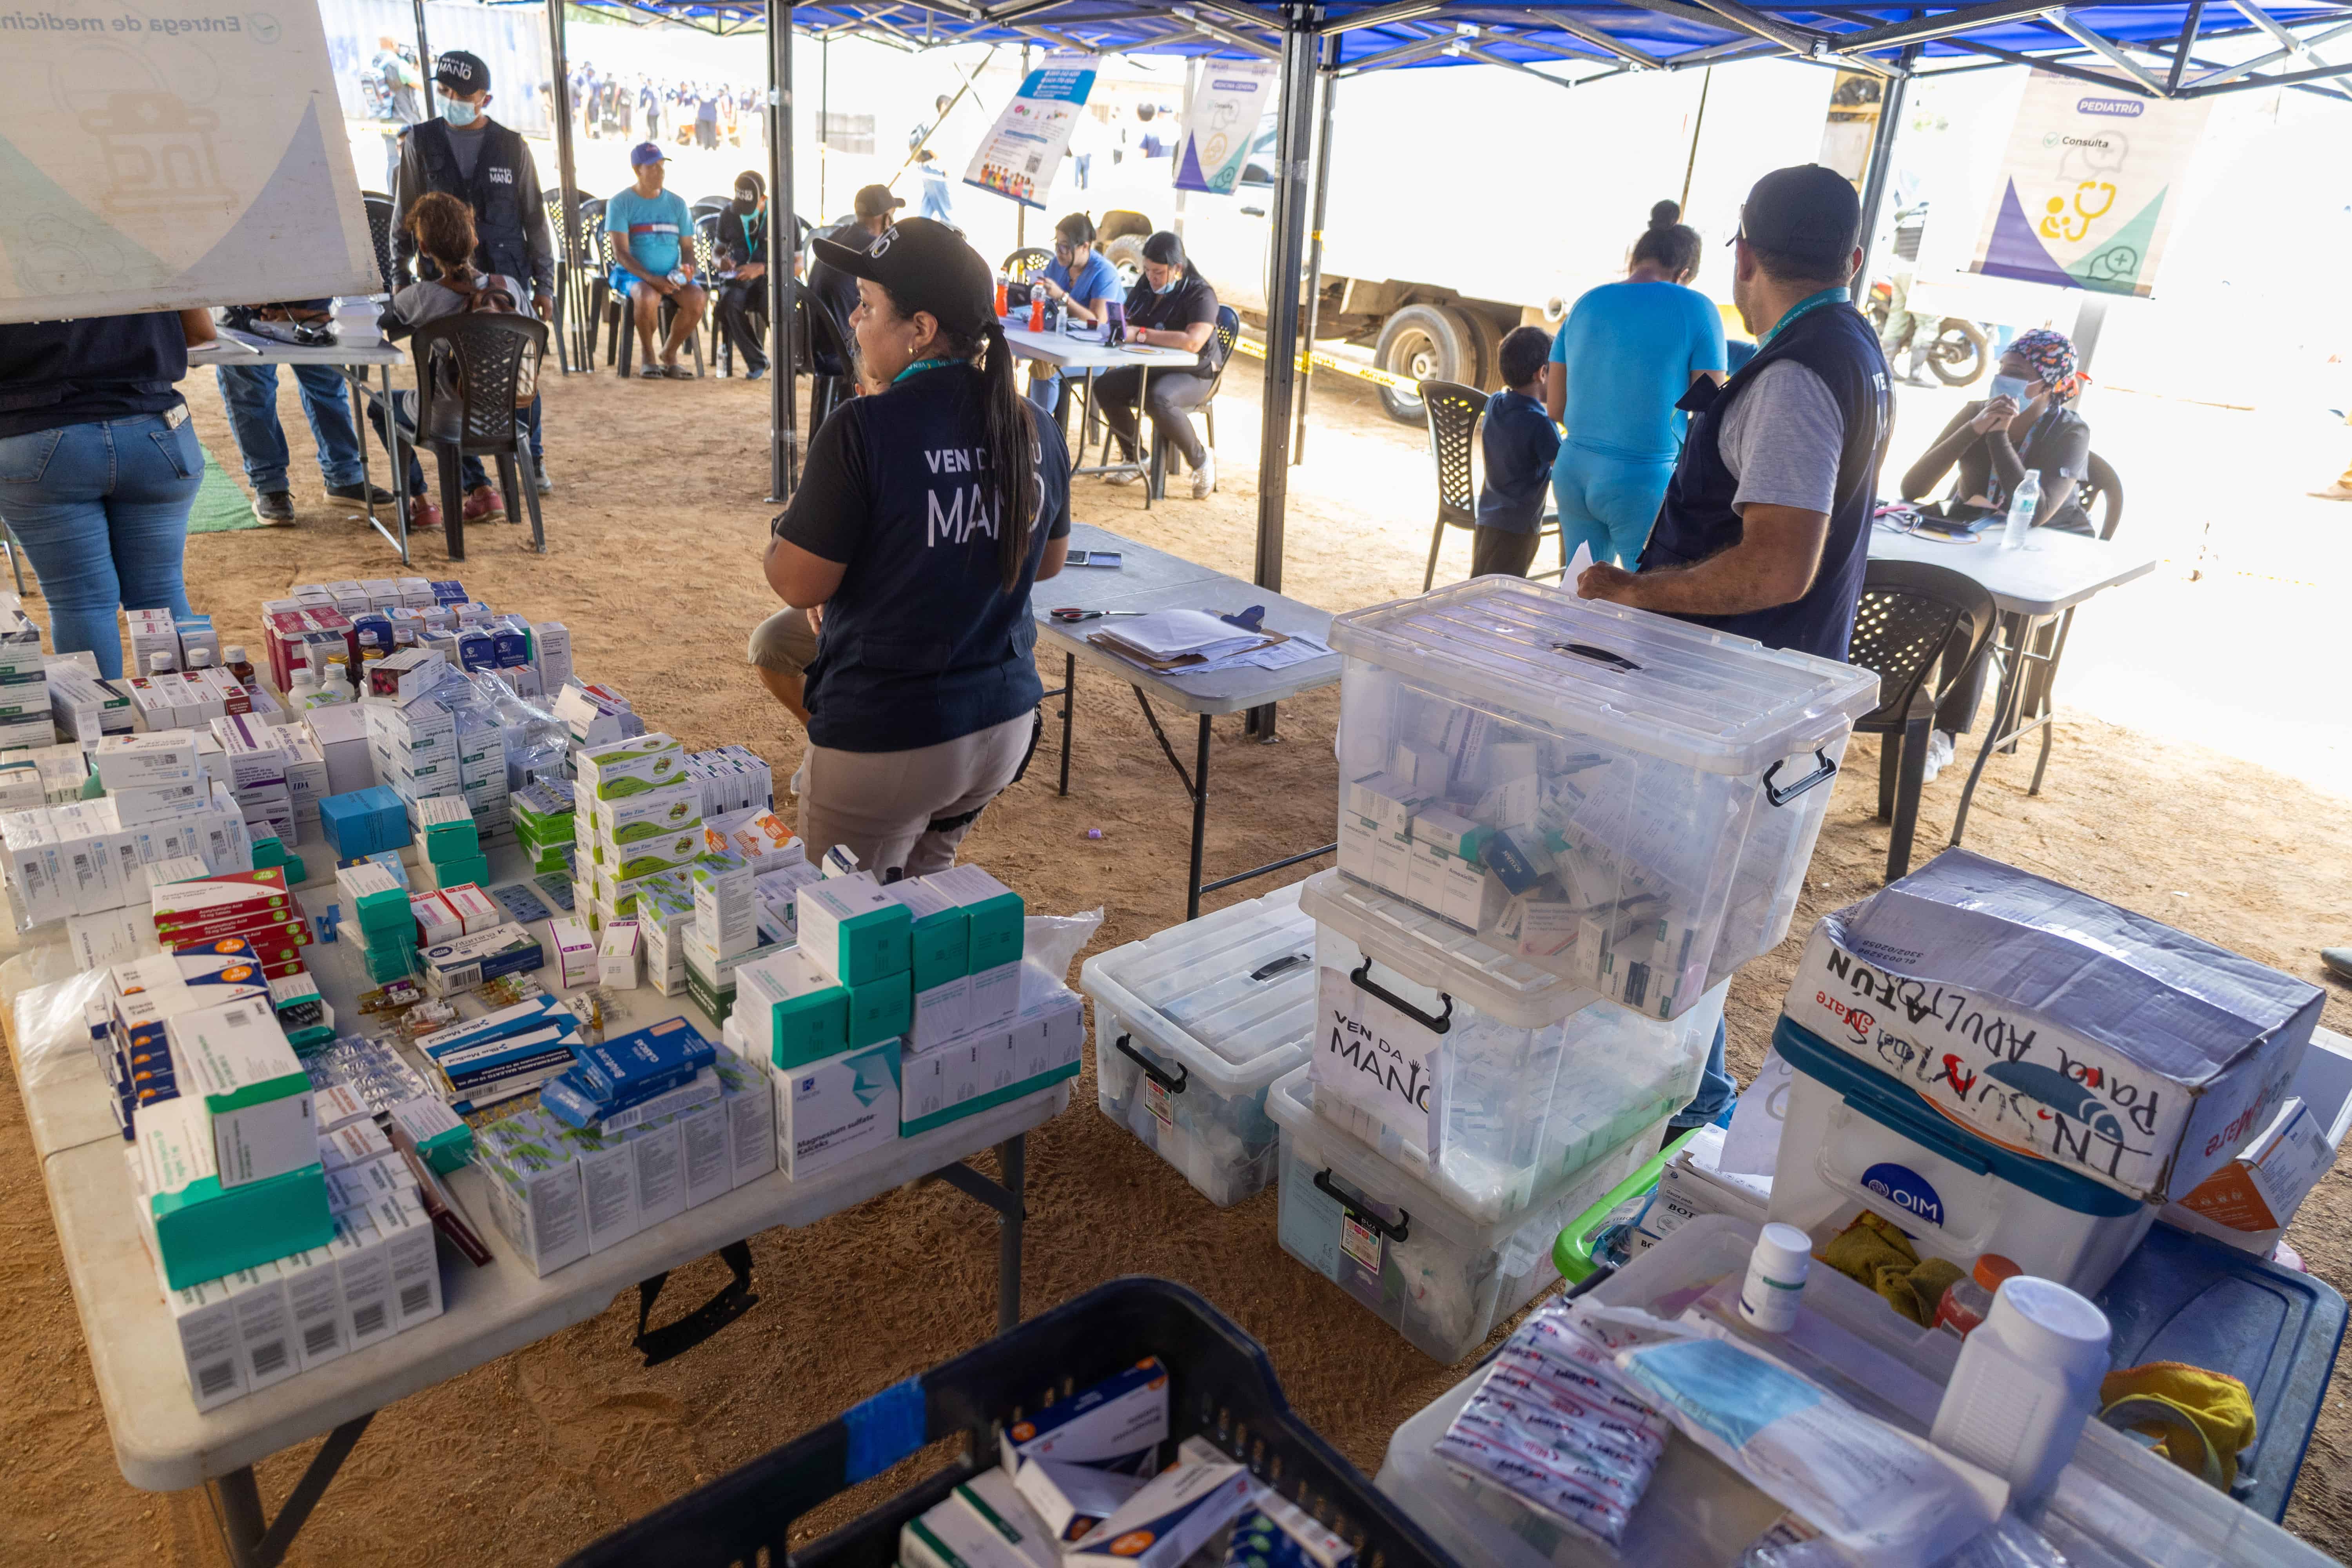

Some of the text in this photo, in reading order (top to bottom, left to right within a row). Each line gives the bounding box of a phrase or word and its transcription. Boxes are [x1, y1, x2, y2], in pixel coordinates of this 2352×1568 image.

[438, 62, 471, 80] MANO
[2080, 101, 2141, 114] PEDIATRÍA
[2062, 136, 2109, 148] Consulta
[490, 168, 512, 185] MANO
[924, 448, 971, 474] VEN
[293, 782, 309, 790] IDA
[1344, 823, 1371, 838] Amoxicillin
[1377, 837, 1405, 853] Amoxicillin
[1413, 852, 1441, 868] Amoxicillin
[1448, 867, 1478, 884] Amoxicillin
[450, 932, 496, 948] Vitamina
[1826, 948, 1933, 1024] ATÚN
[1816, 990, 1874, 1034] Mare
[427, 1023, 481, 1044] Blue Medical
[1334, 1009, 1403, 1064] VEN DA
[448, 1046, 499, 1065] Blue Medical
[2057, 1047, 2159, 1135] Para
[797, 1125, 846, 1149] Magnesium
[797, 1140, 820, 1156] Kalceks
[1666, 1190, 1681, 1198] Gauze
[1668, 1203, 1696, 1218] BOT
[1893, 1189, 1937, 1220] OIM
